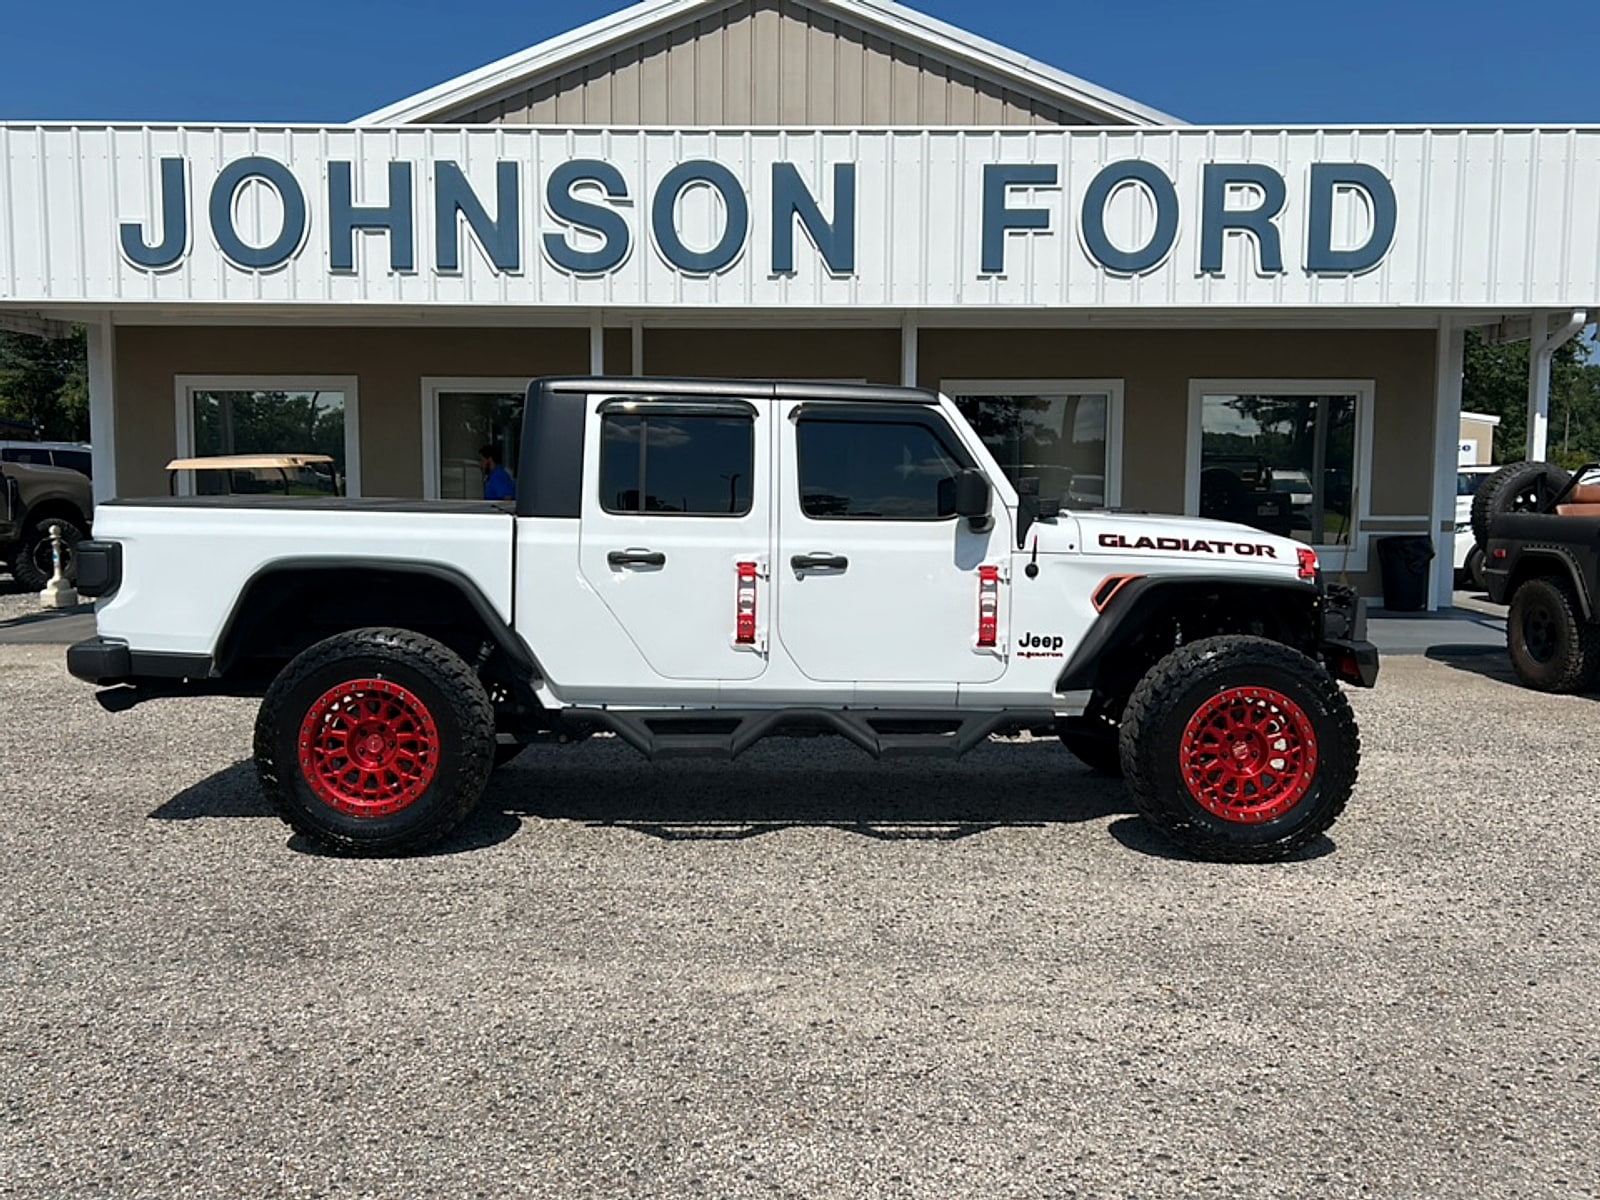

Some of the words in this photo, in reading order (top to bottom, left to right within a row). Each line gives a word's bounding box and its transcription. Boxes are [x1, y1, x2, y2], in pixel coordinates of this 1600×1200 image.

[119, 156, 856, 276] JOHNSON
[980, 159, 1398, 277] FORD
[1098, 533, 1278, 559] GLADIATOR
[1018, 631, 1064, 651] Jeep
